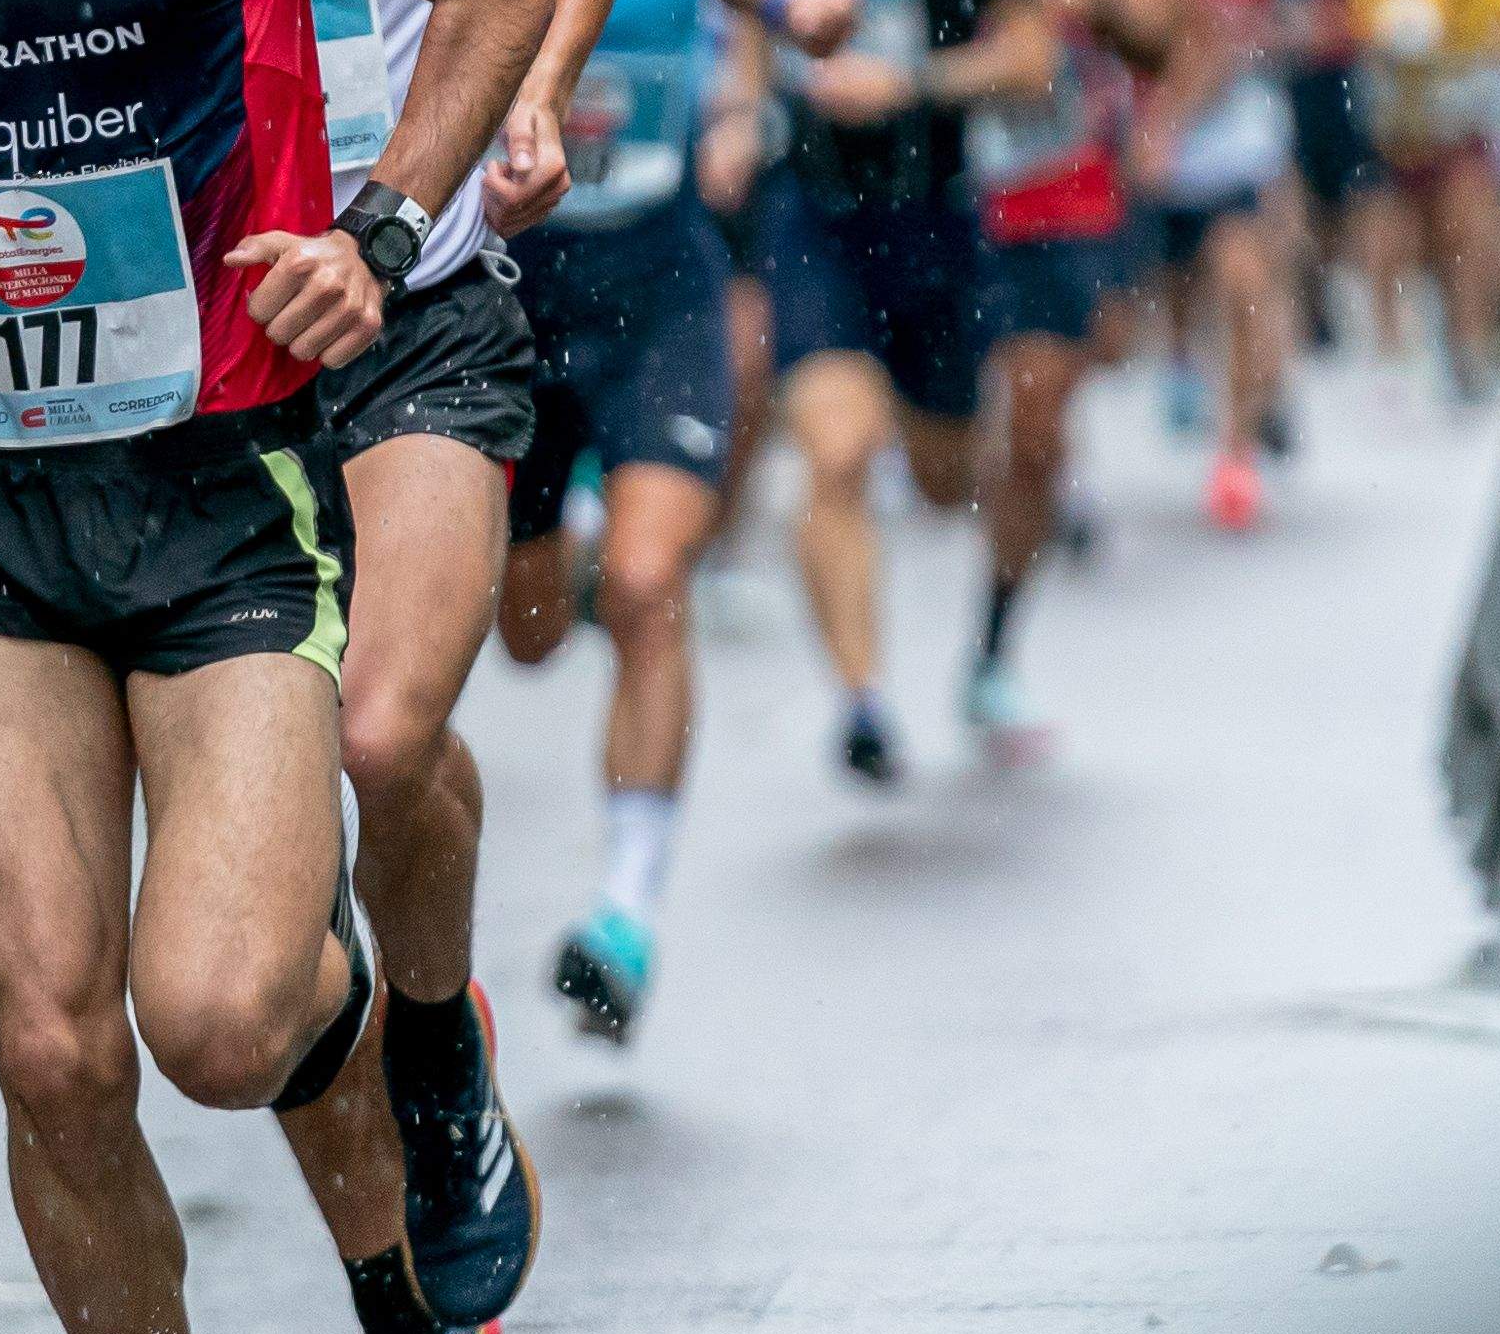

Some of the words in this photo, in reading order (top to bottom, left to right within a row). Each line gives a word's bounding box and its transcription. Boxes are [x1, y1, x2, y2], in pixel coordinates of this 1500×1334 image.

[13, 266, 49, 277] MILLA
[5, 290, 20, 300] DE
[22, 285, 64, 298] MADRID
[47, 403, 85, 414] MILLA
